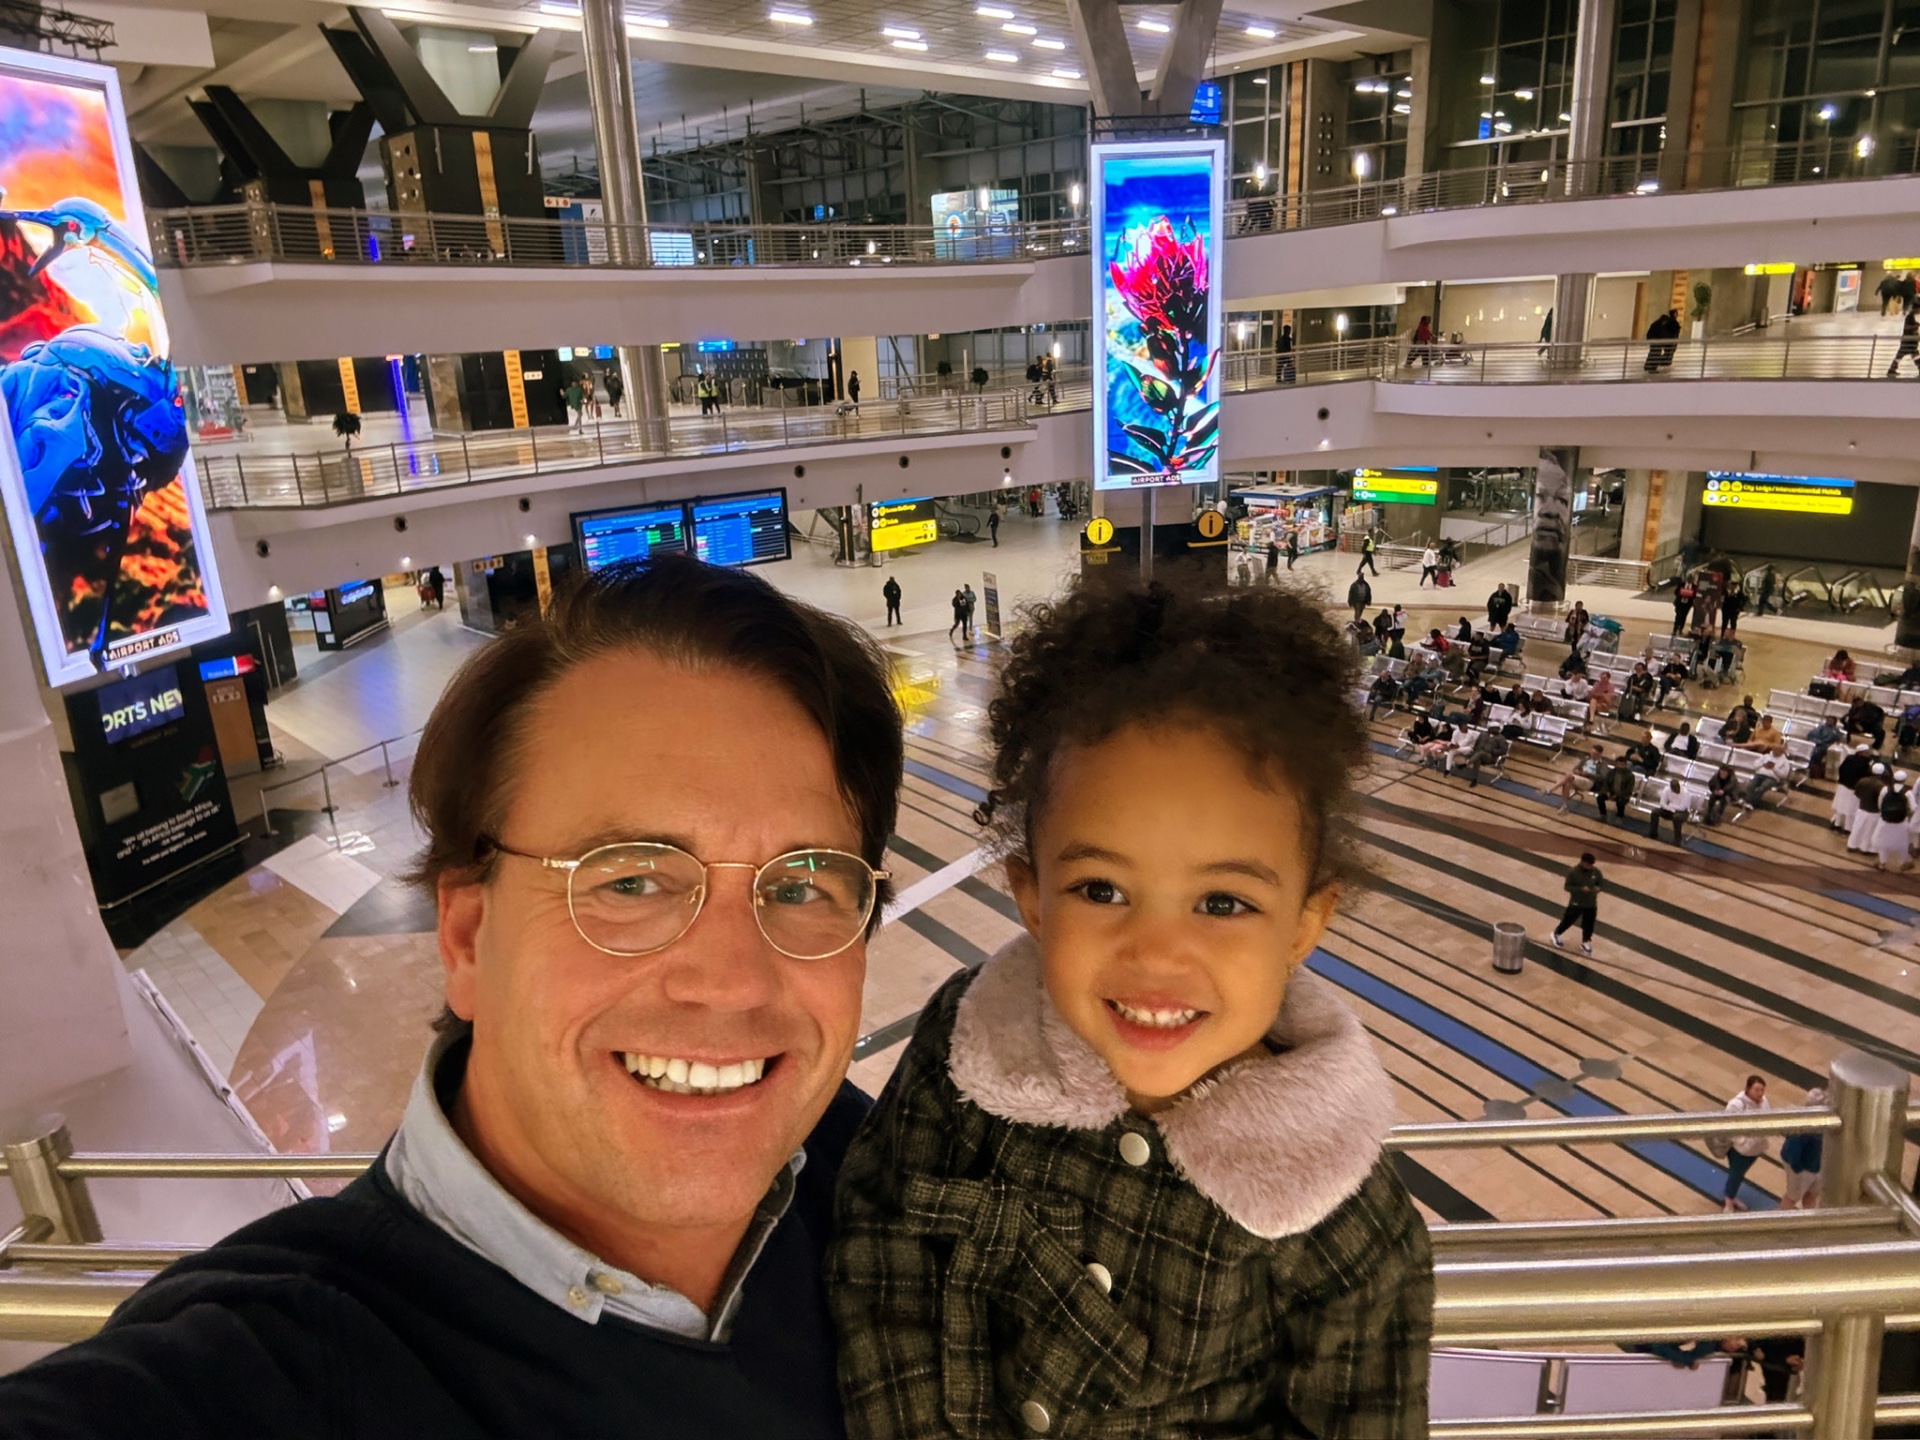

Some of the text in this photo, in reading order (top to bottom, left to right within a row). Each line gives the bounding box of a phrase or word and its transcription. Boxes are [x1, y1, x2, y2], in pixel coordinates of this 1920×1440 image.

[1132, 474, 1181, 483] AIRPORT ADS
[109, 631, 179, 661] AIRPORT ADS
